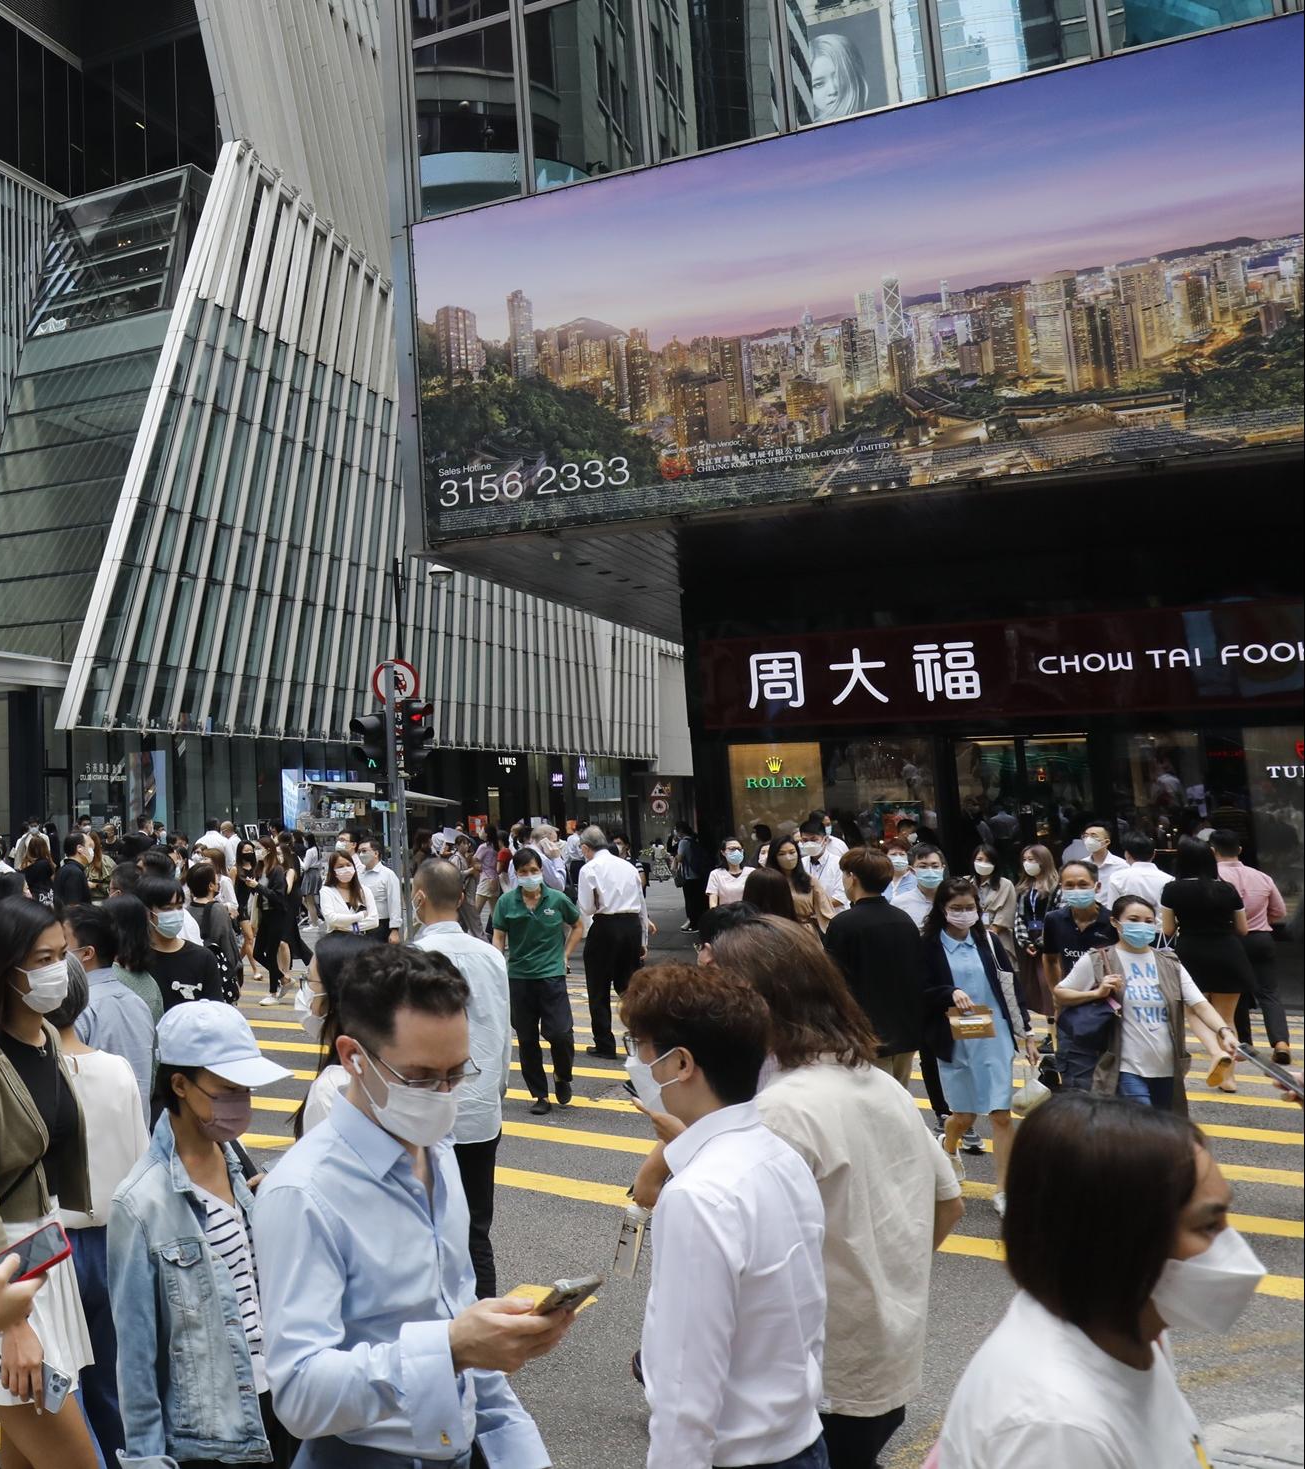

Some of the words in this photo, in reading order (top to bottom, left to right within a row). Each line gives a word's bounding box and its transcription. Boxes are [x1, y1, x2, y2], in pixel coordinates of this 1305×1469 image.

[696, 463, 730, 473] CHEUNG
[731, 459, 754, 469] KONG
[755, 454, 794, 465] PROPERTY
[795, 446, 855, 460] DEVELOPMENT
[856, 442, 890, 453] LIMITED
[438, 465, 461, 477] Sales
[462, 462, 492, 474] Hotline
[439, 470, 524, 507] 3156
[537, 456, 631, 495] 2333
[1038, 651, 1134, 675] CHOW
[1145, 647, 1202, 669] TAI
[749, 641, 981, 709] 周大福
[498, 757, 517, 766] LINKS
[745, 775, 807, 790] ROLEX
[1128, 963, 1157, 980] AN
[1132, 1006, 1168, 1023] THIS
